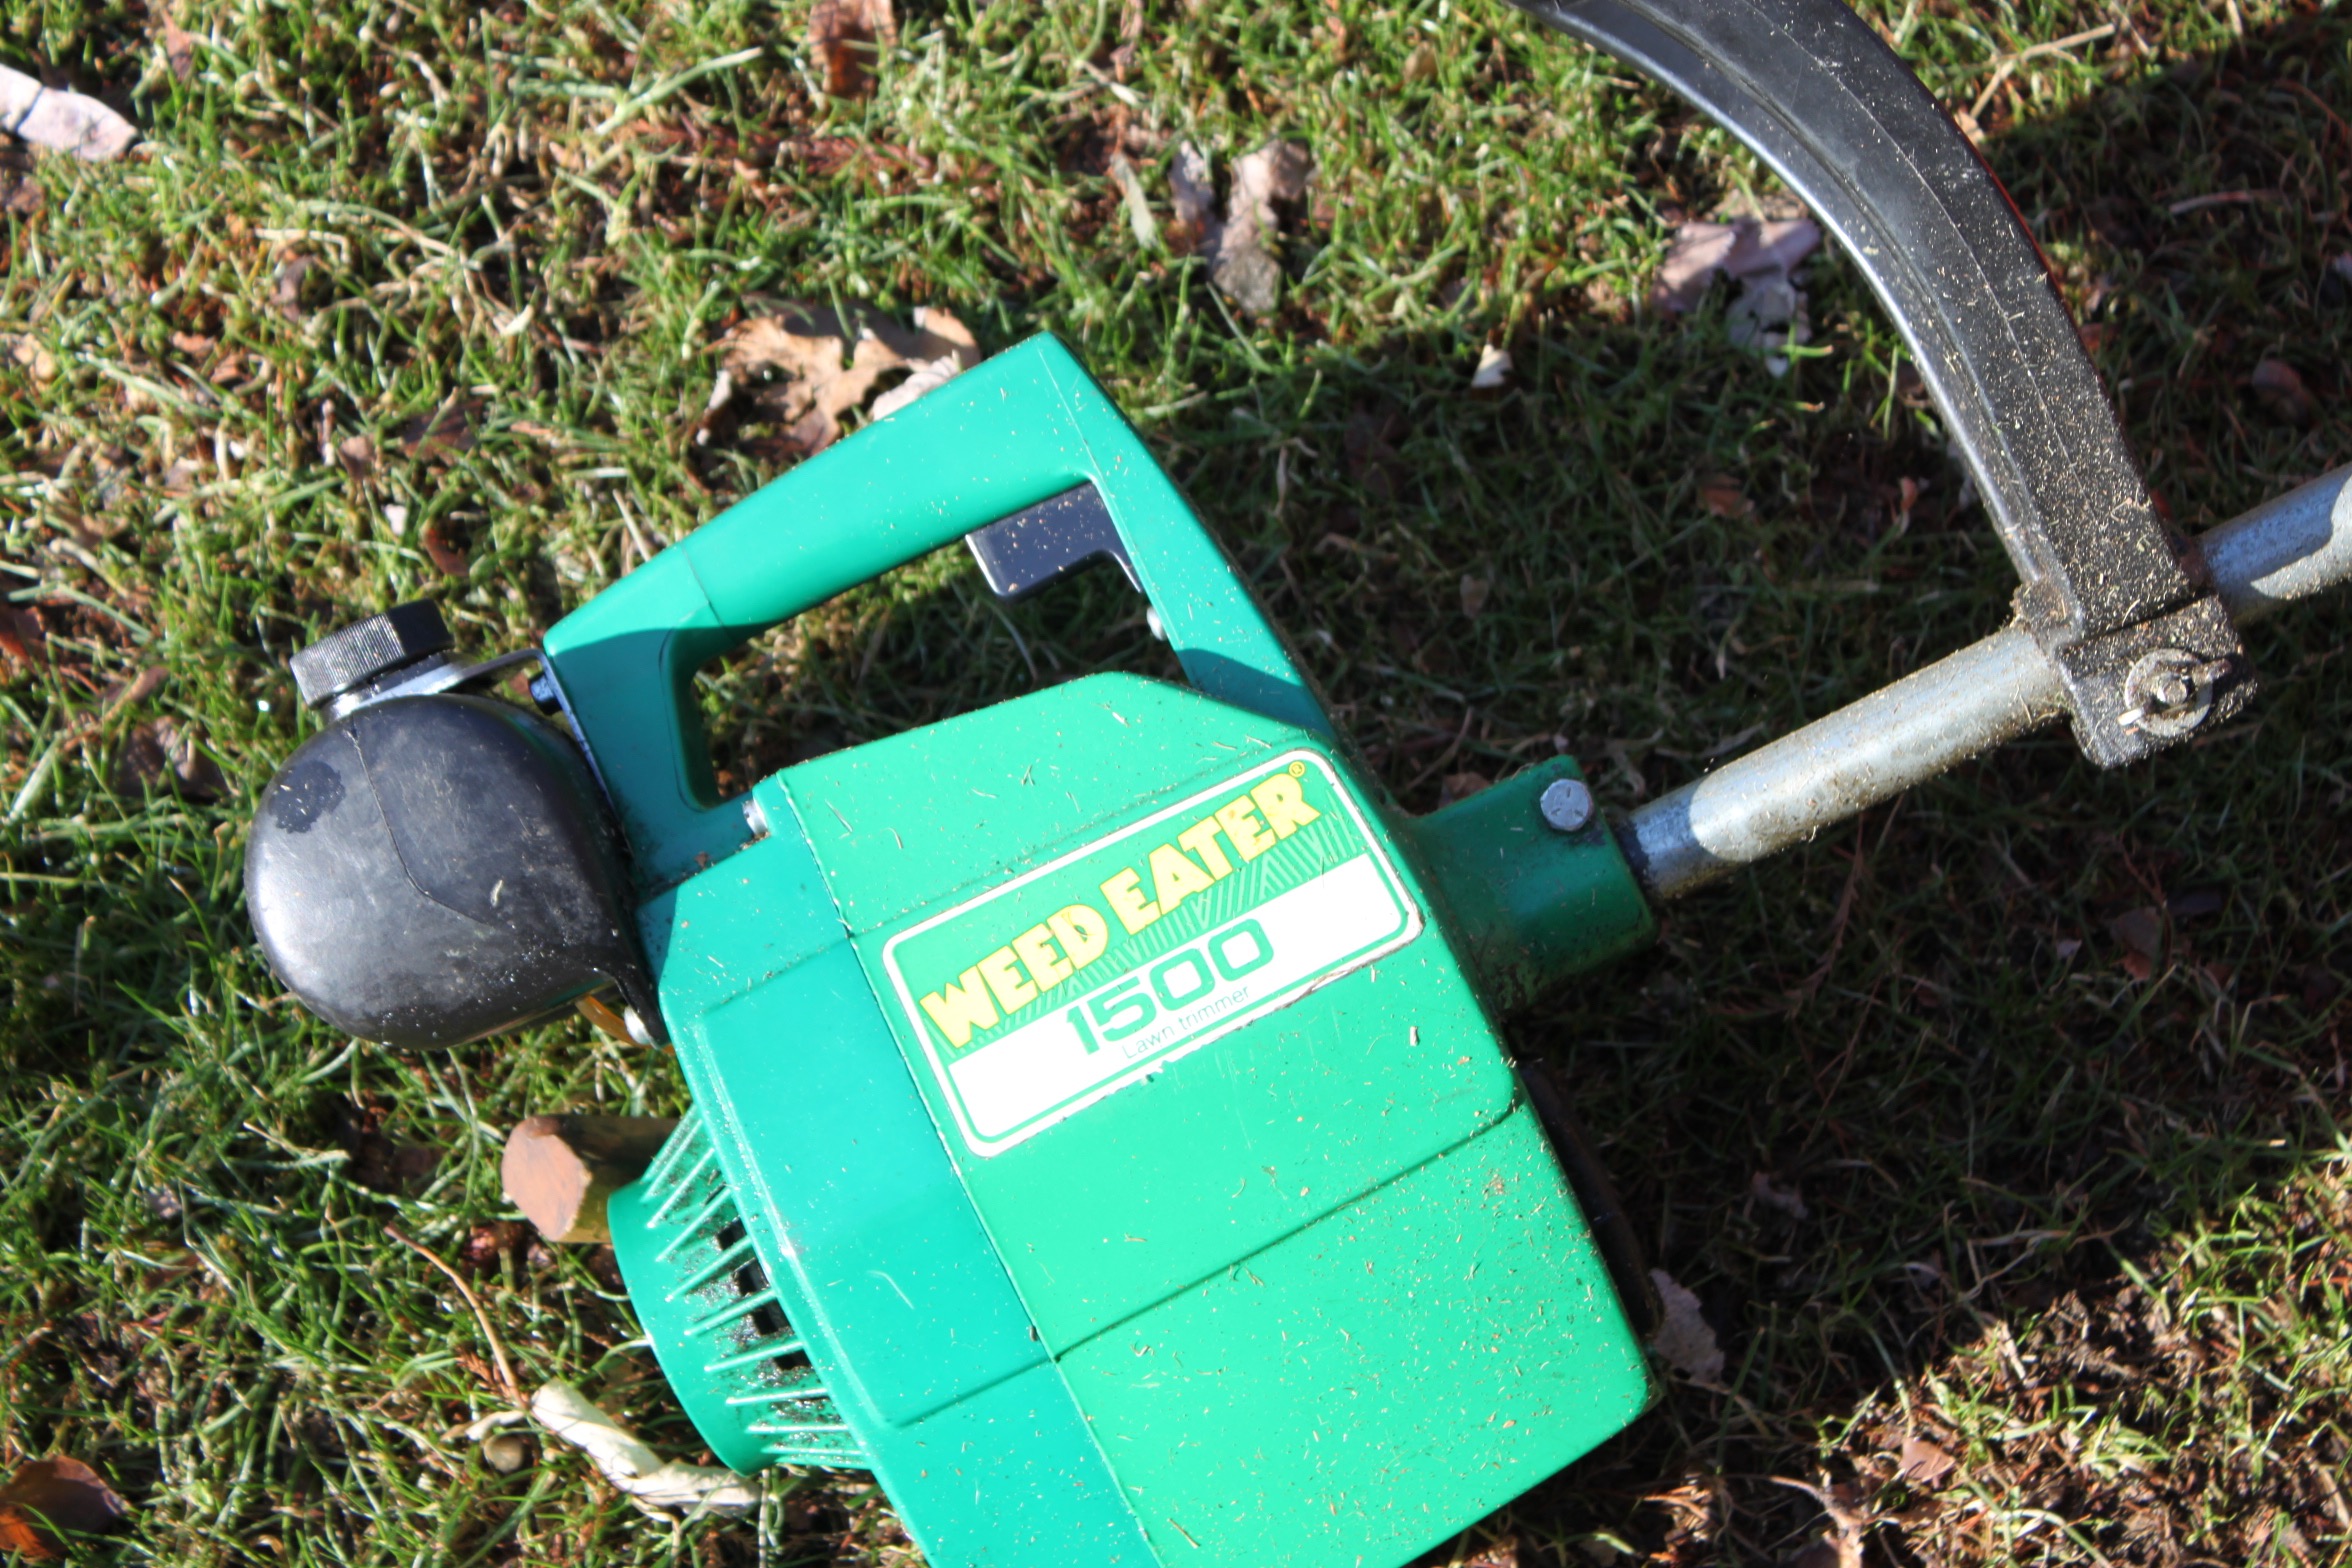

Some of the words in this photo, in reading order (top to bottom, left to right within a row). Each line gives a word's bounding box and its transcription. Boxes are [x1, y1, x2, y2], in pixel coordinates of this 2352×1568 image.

[920, 904, 1109, 1048] WEED
[1066, 918, 1274, 1055] 1500
[1122, 1024, 1175, 1059] Lawn
[1178, 985, 1249, 1032] trimmer
